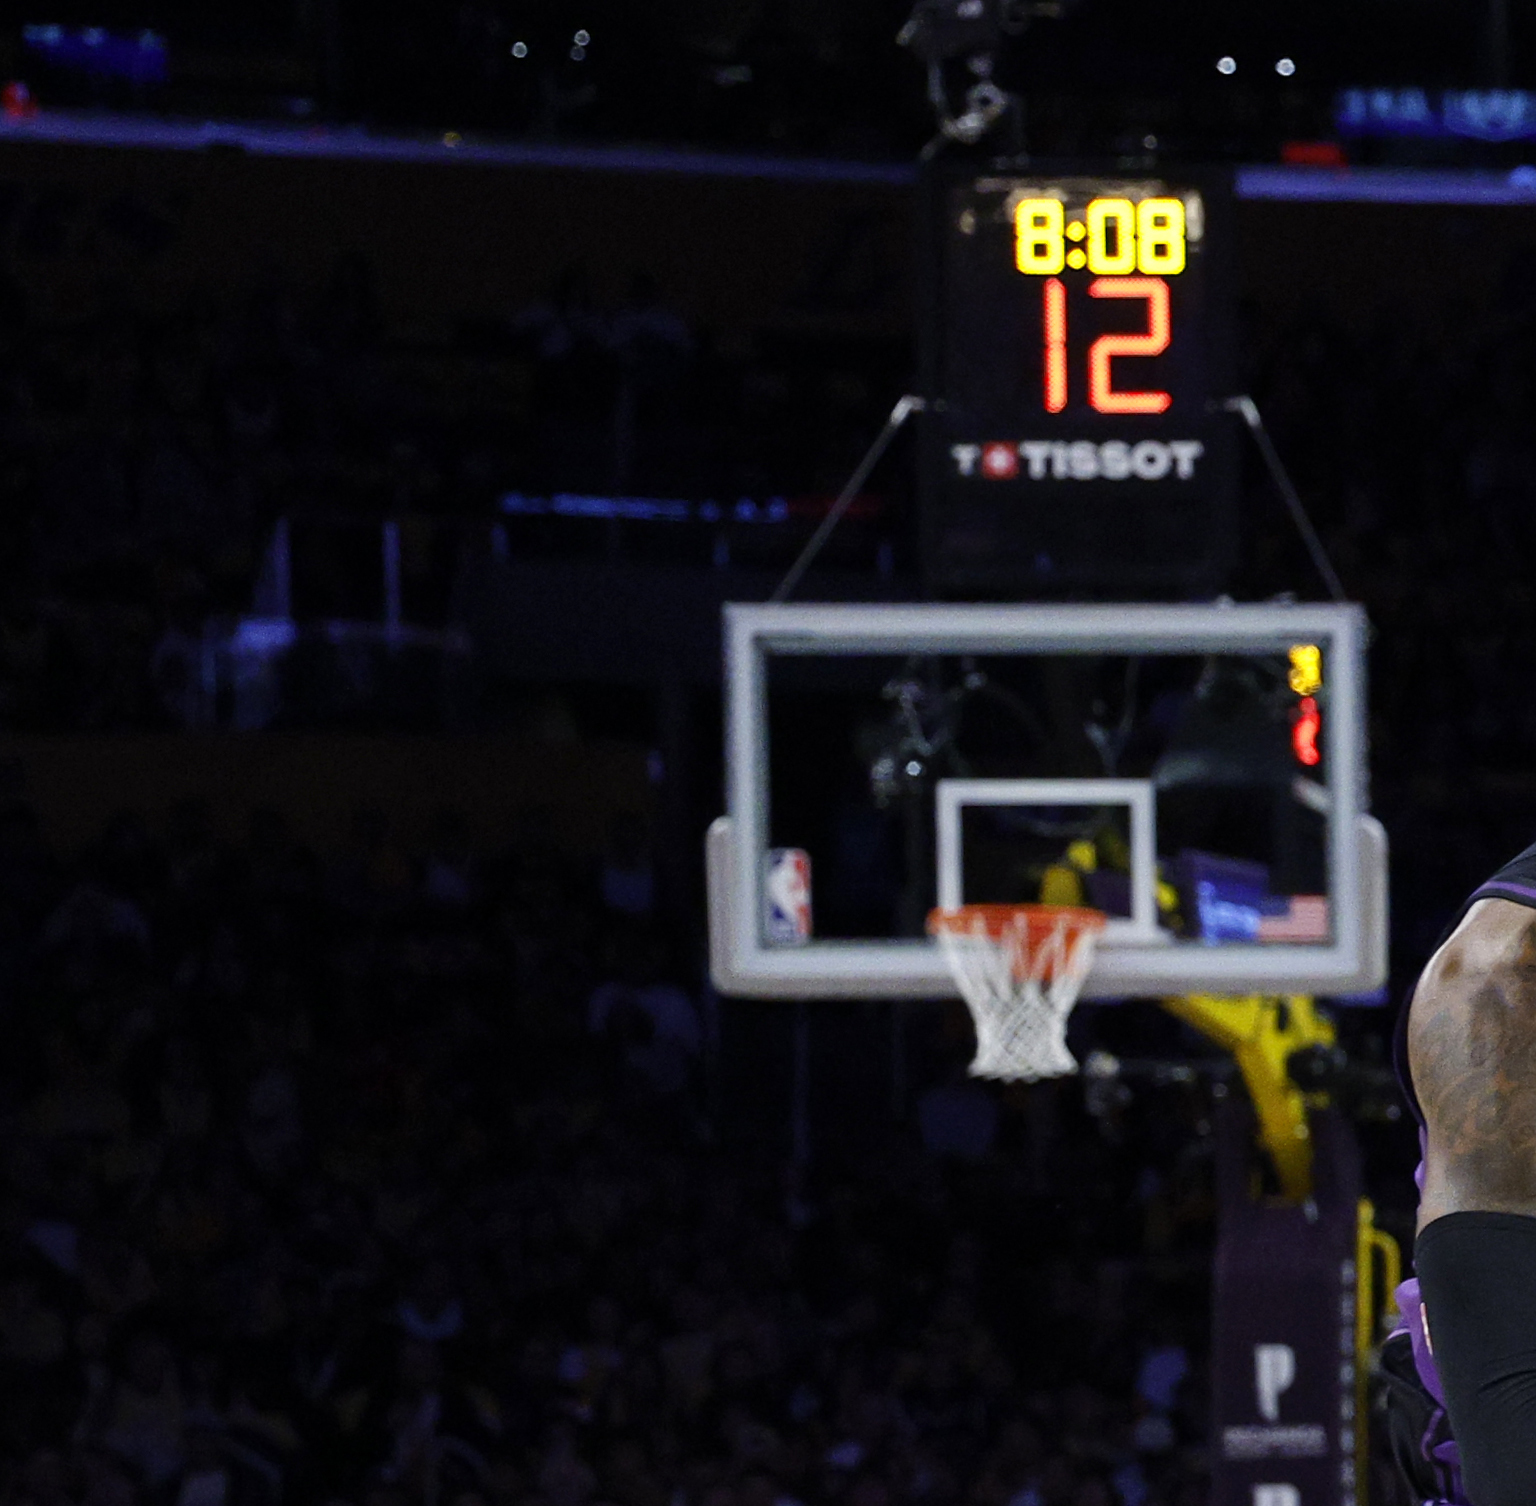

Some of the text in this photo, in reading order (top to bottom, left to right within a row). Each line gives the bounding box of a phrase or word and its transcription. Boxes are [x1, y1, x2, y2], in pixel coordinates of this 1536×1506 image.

[1014, 197, 1187, 276] 8:08
[1042, 276, 1173, 415] 12
[1020, 440, 1203, 480] TISSOT
